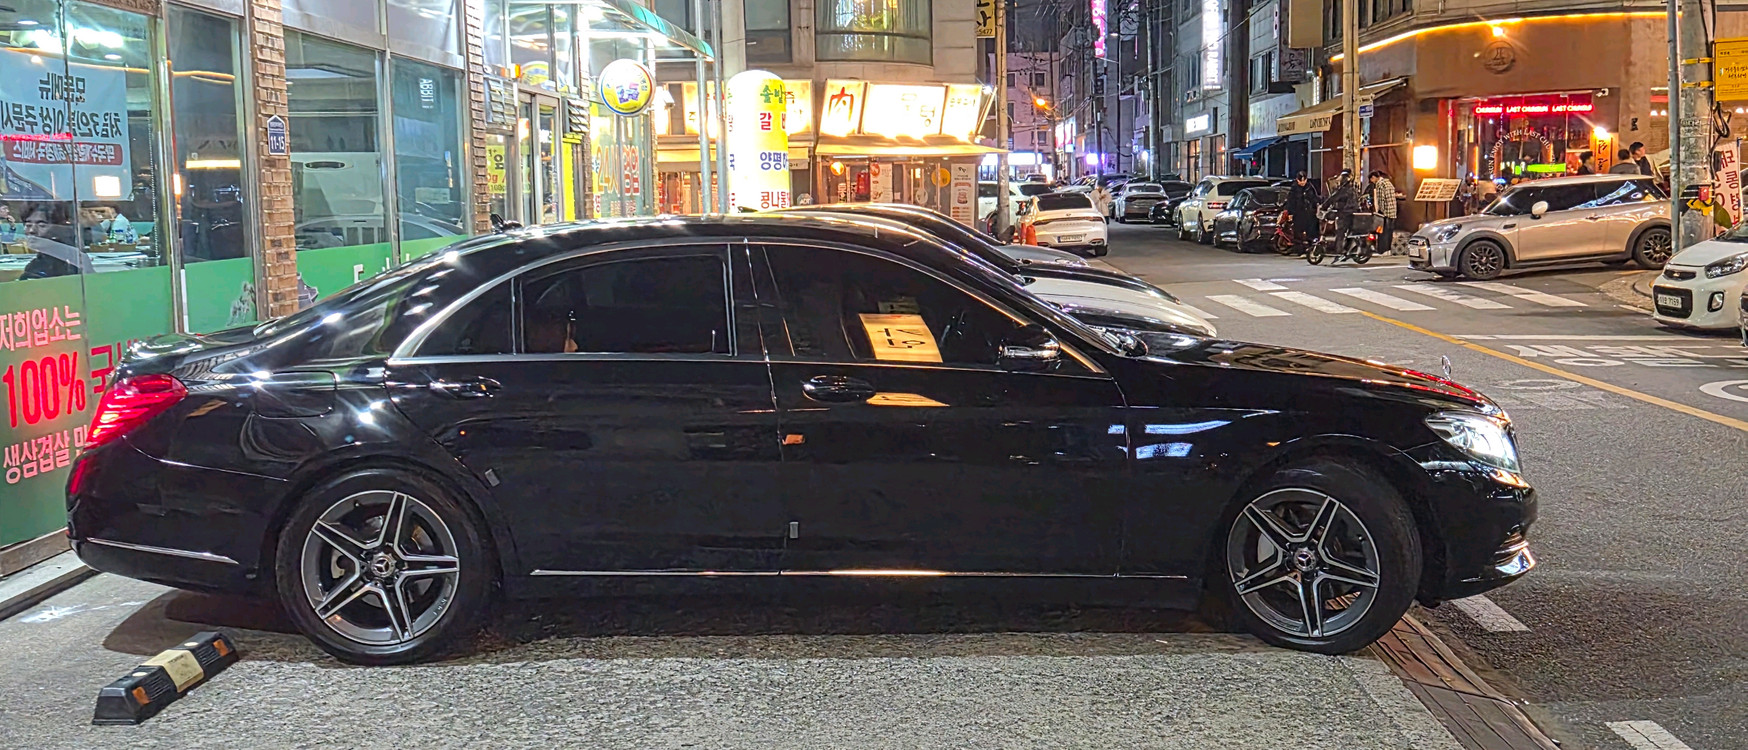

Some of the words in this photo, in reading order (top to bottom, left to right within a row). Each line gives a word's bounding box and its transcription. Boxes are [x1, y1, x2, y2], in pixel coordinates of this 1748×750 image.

[270, 135, 285, 150] 11-15
[760, 191, 790, 210] 콩나물
[0, 305, 81, 352] 저희업소는
[2, 351, 86, 428] 100%
[2, 431, 71, 485] 생삼겹살
